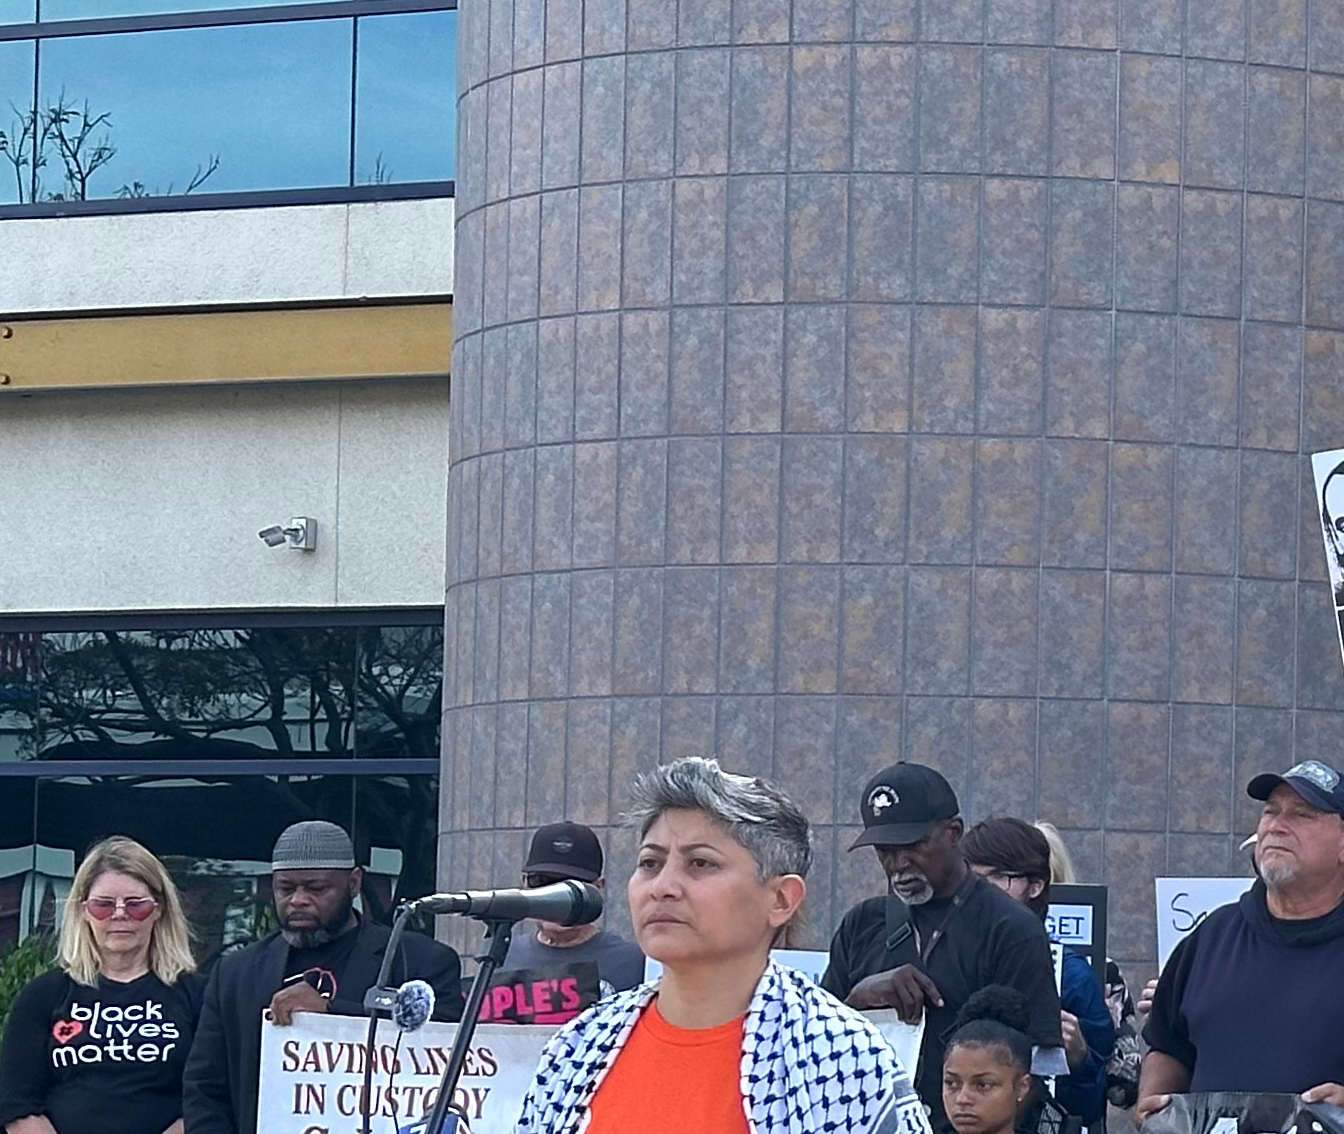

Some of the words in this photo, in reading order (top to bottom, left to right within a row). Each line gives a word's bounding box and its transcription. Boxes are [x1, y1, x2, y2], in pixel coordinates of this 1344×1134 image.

[71, 1000, 162, 1024] black
[89, 1020, 180, 1039] lives
[52, 1039, 176, 1067] matter
[282, 1040, 402, 1077] SAVING
[292, 1083, 327, 1115] IN
